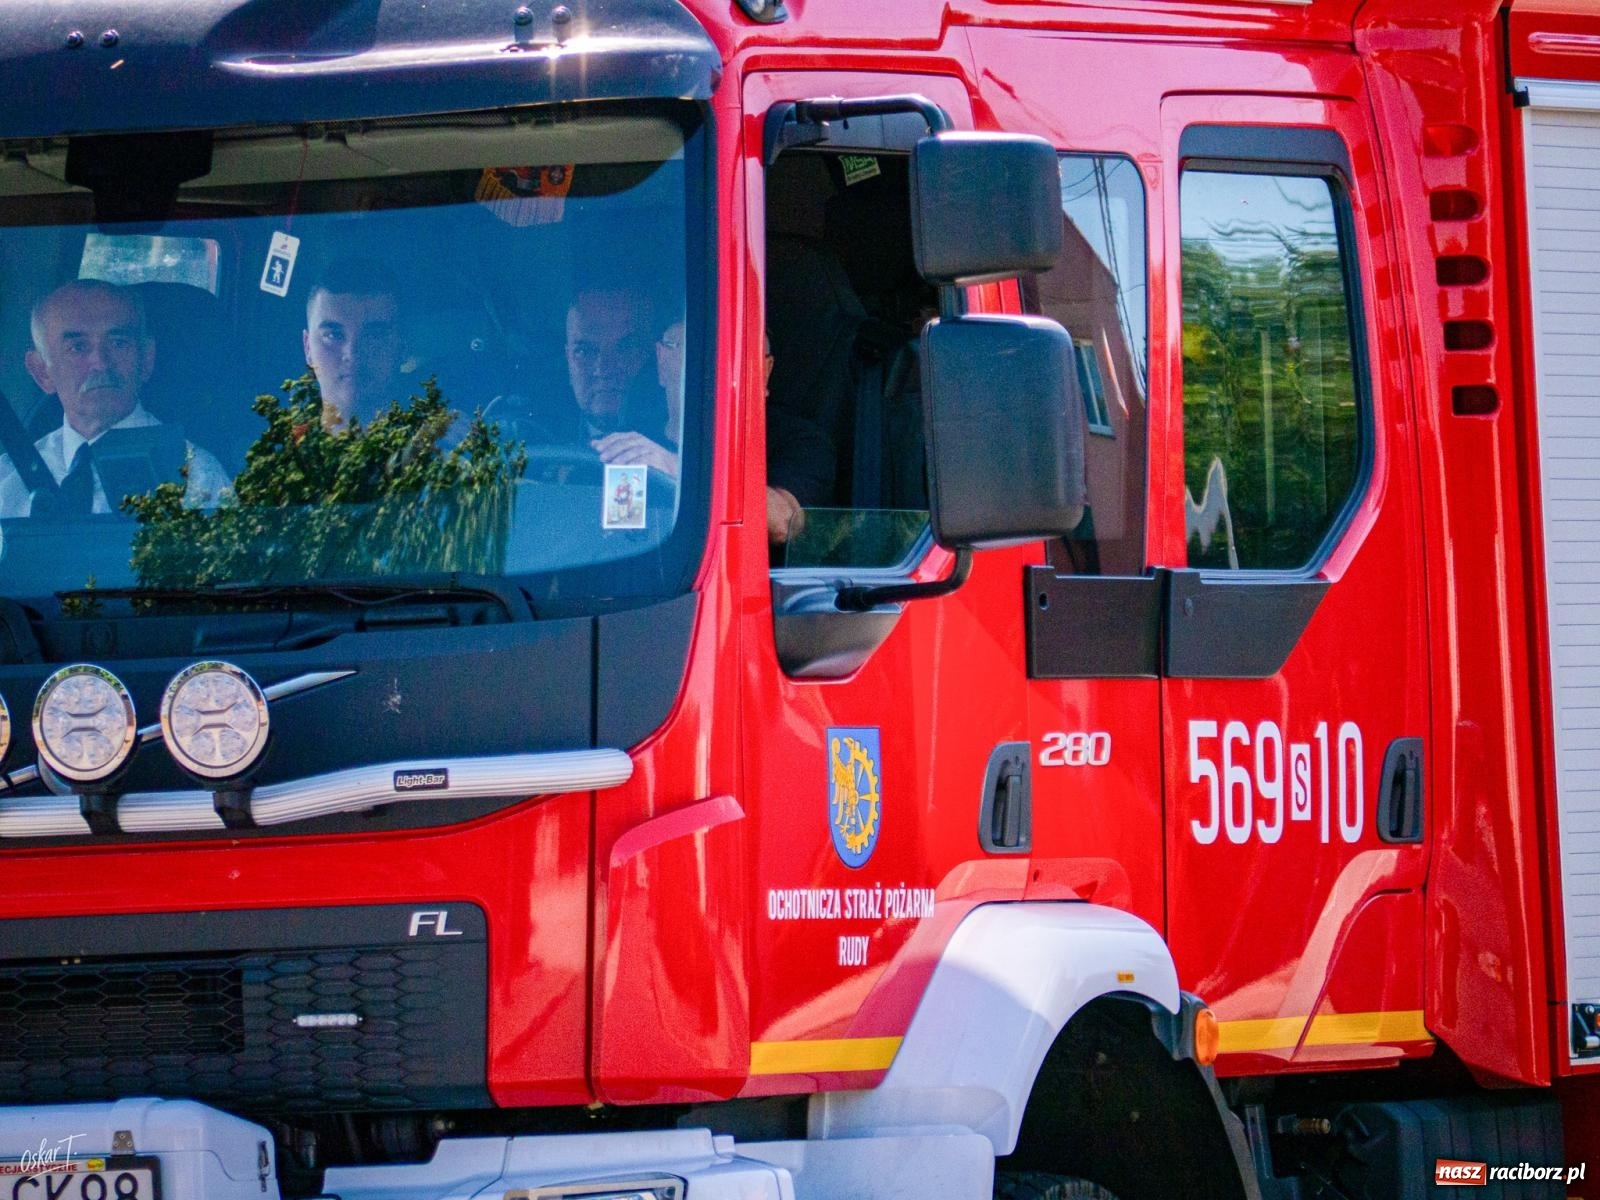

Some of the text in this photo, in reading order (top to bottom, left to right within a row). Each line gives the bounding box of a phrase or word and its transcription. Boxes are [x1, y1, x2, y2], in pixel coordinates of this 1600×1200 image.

[1039, 731, 1112, 767] 280
[396, 774, 446, 788] Light-Bar
[768, 881, 936, 920] OCHOTNICZA STRAŻ POŻARNA
[408, 910, 464, 937] FL
[838, 935, 870, 966] RUDY
